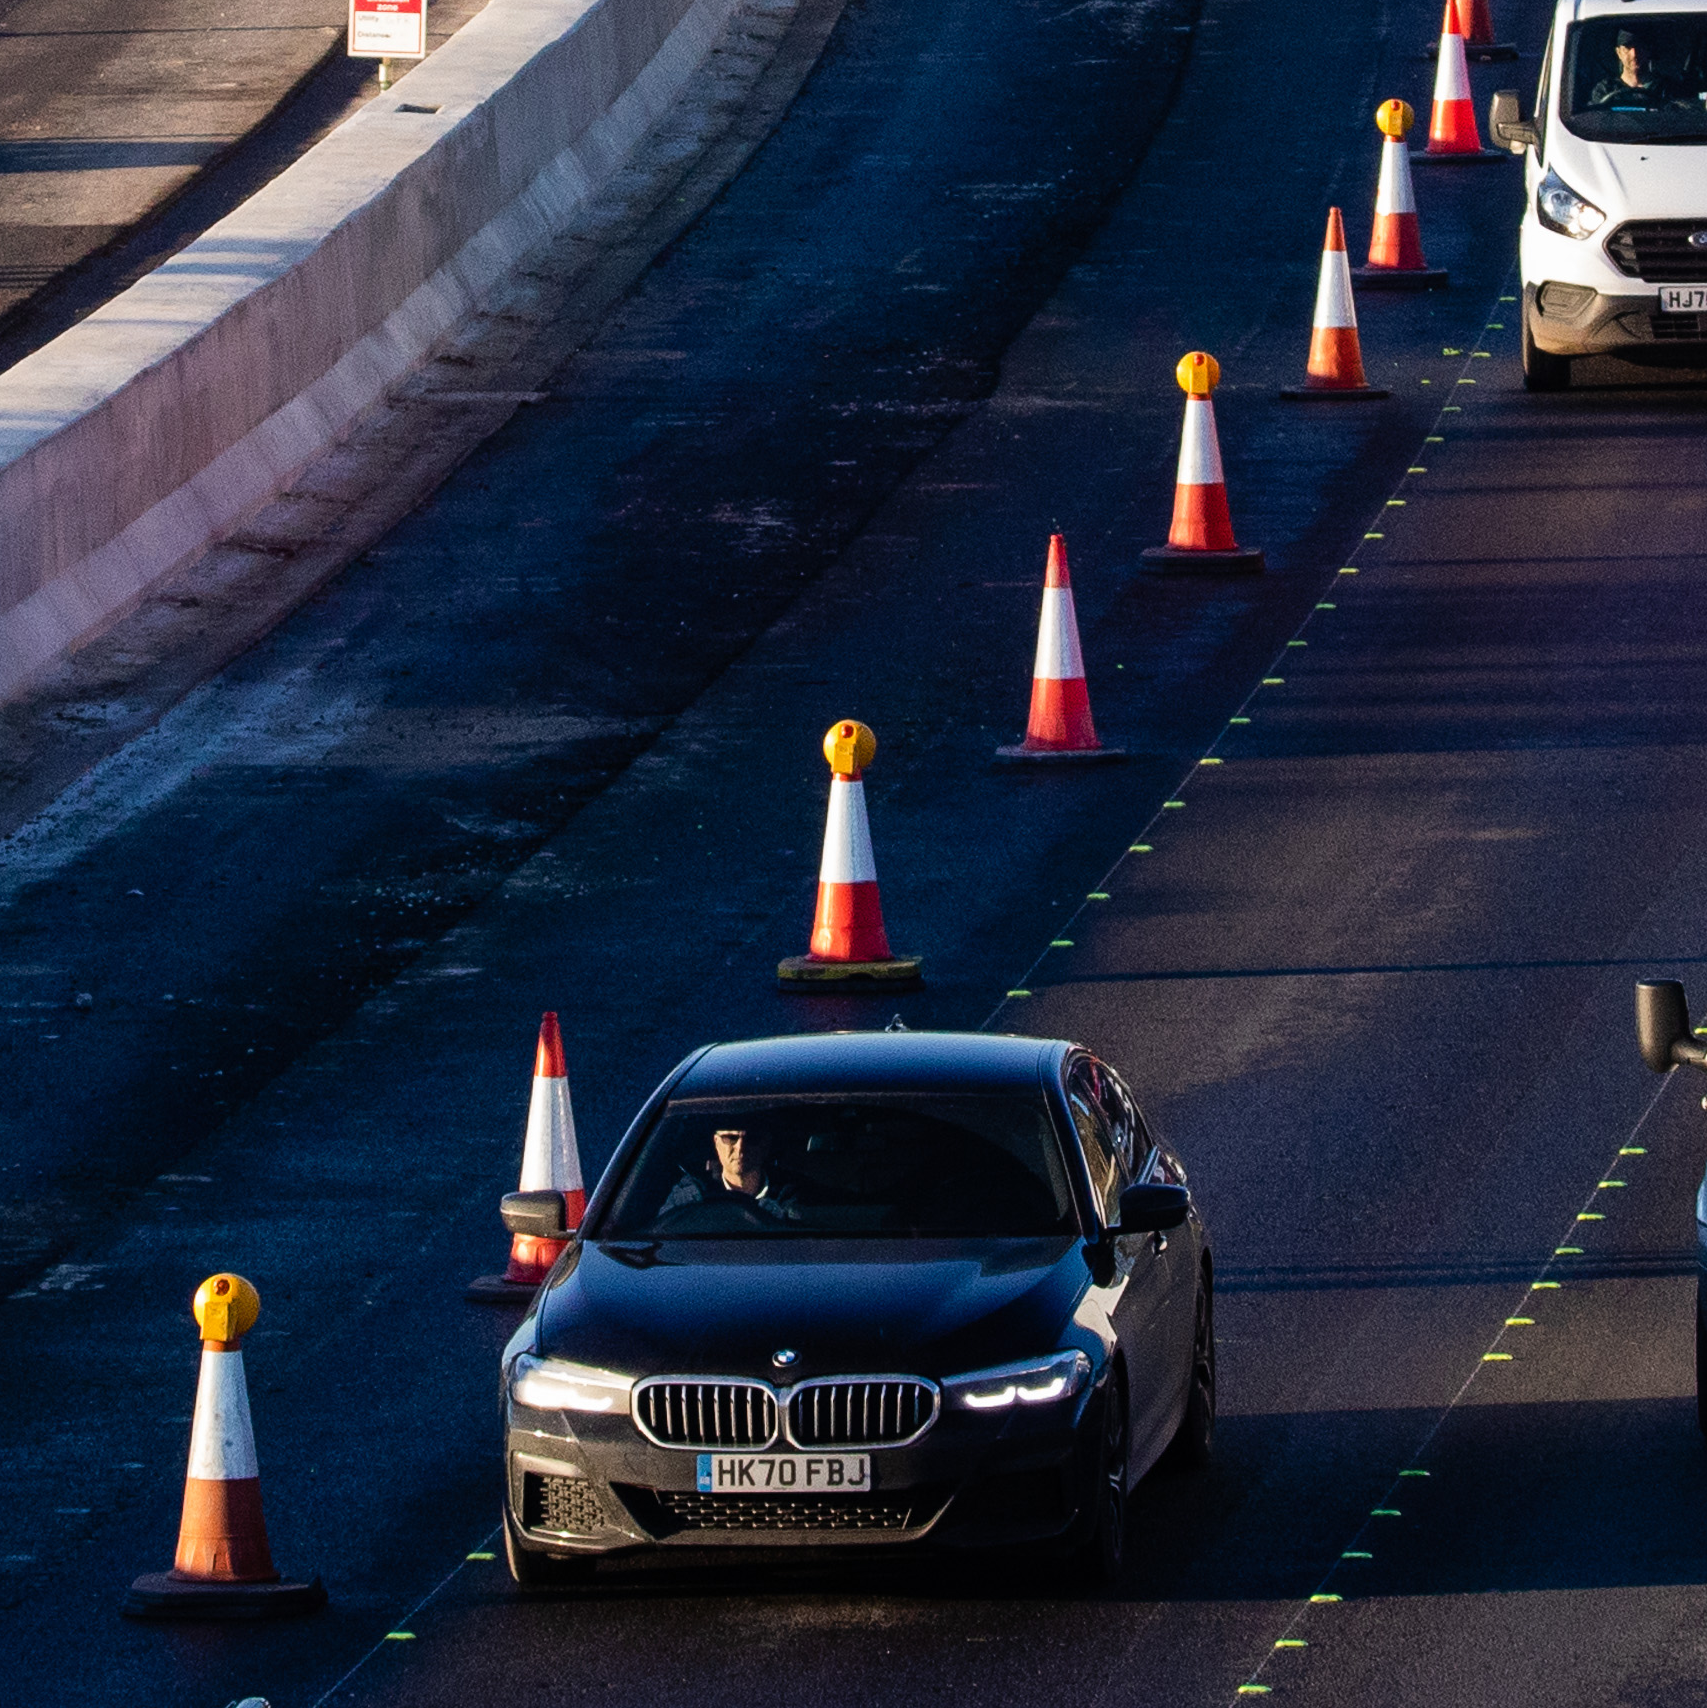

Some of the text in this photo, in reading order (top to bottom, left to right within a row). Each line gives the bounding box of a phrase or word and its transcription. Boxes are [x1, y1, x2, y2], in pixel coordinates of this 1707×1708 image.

[376, 3, 399, 12] zone
[717, 1458, 865, 1487] HK70 FBJ
